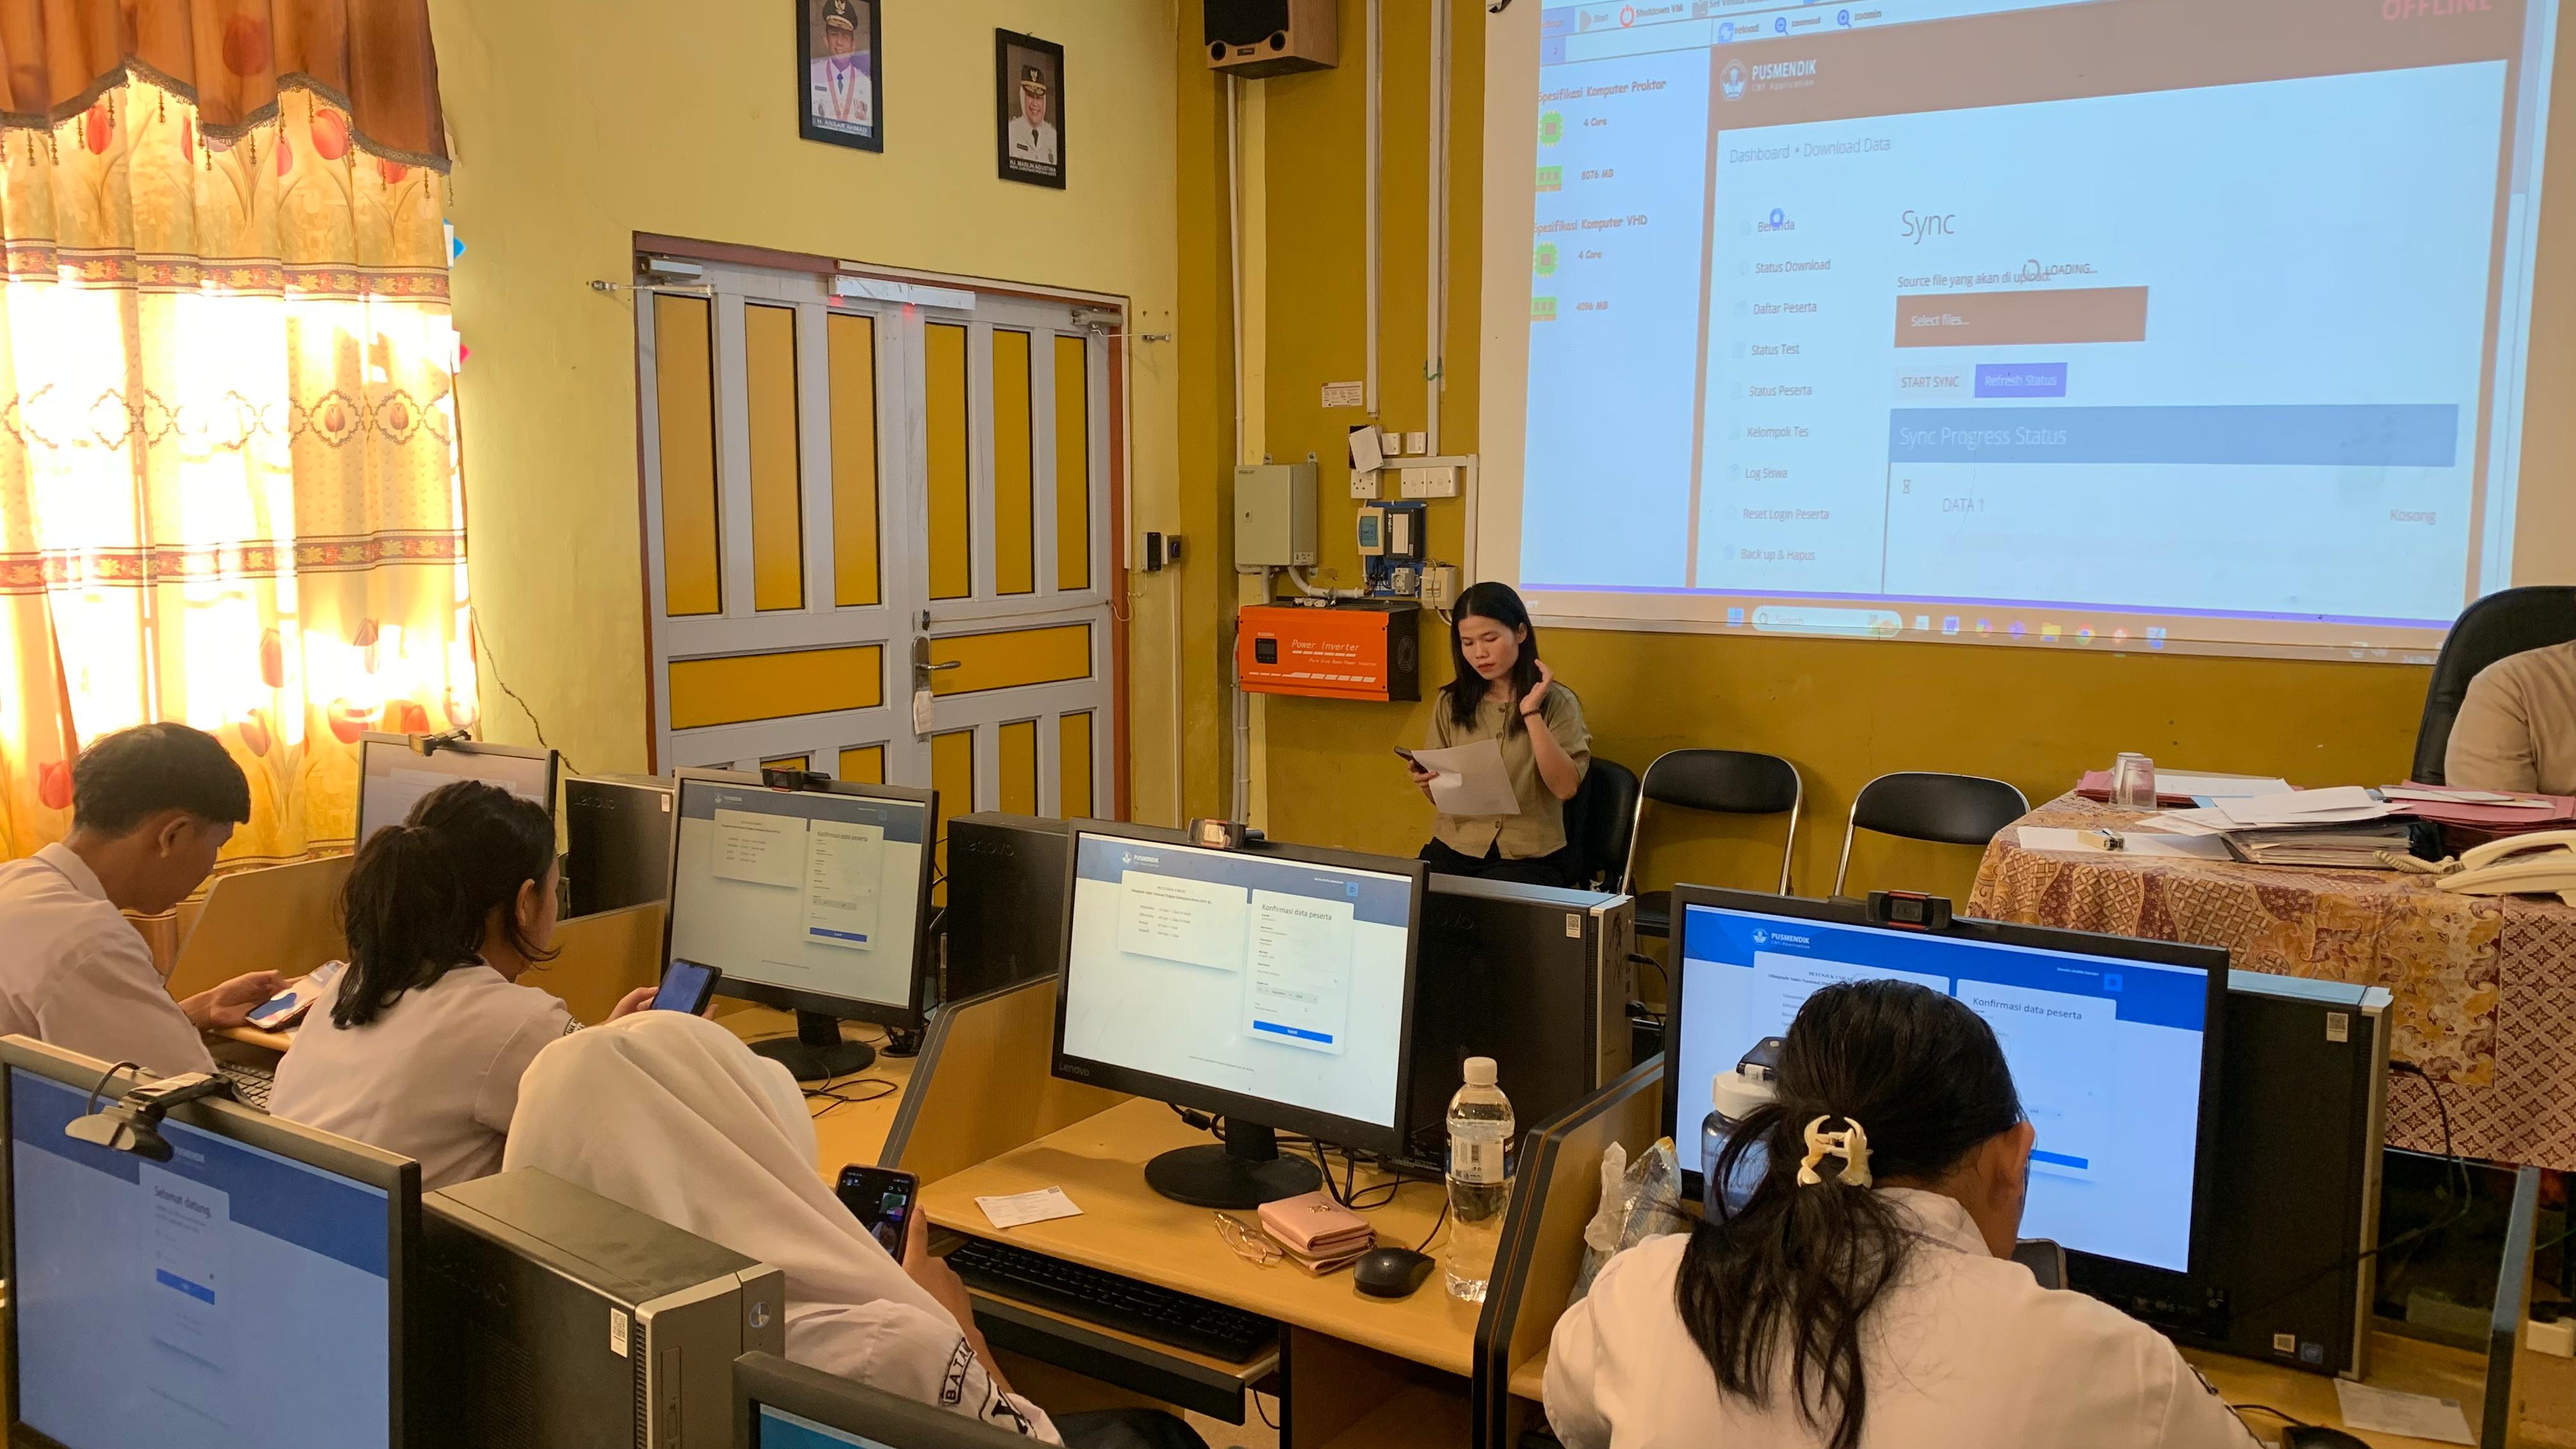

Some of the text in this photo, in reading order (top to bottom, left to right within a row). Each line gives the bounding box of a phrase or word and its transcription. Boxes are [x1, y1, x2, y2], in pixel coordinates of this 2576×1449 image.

[1636, 8, 1669, 18] Shutdown
[1671, 4, 1683, 13] VM
[1751, 59, 1817, 80] PUSMENDIK
[1538, 79, 1667, 106] Spesifikasi Komputer Proktor
[1590, 118, 1607, 126] Core
[846, 125, 868, 133] AHMAD
[1729, 138, 1891, 163] Dashboard Download Data
[1601, 168, 1614, 178] MB
[1533, 215, 1648, 236] Spesifikasi Komputer VHD
[1901, 210, 1956, 245] Sync
[1578, 250, 1602, 259] 4 Core
[1755, 259, 1832, 274] Status Download
[1897, 276, 1930, 288] Source
[1932, 274, 1948, 286] file
[1949, 275, 1973, 288] yang
[1975, 273, 1999, 285] akan
[2002, 272, 2012, 283] di
[1595, 300, 1608, 310] MB
[1753, 302, 1817, 315] Daftar Peserta
[1911, 316, 1940, 327] Select
[1751, 344, 1800, 356] Status Test
[1901, 376, 1960, 388] START SYNC
[1984, 374, 2058, 387] Refresh Status
[1749, 385, 1812, 397] Status Peserta
[1747, 426, 1809, 439] Kelompok Tes
[1899, 425, 2067, 450] Sync Progress Status
[1745, 468, 1788, 481] Log Siswa
[1943, 498, 1975, 512] DATA
[1743, 509, 1829, 522] Reset Login Peserta
[2390, 509, 2436, 526] Kosong
[1741, 549, 1761, 560] Back
[1763, 551, 1775, 562] up
[1777, 549, 1784, 560] &
[1291, 639, 1360, 652] Power Inverter
[1262, 903, 1332, 921] Konfirmasi data peserta
[1771, 932, 1810, 944] PUSMENDIK
[1973, 997, 2082, 1020] Konfirmasi data peserta
[1059, 1061, 1090, 1077] Lenovo
[155, 1185, 183, 1204] Selamat
